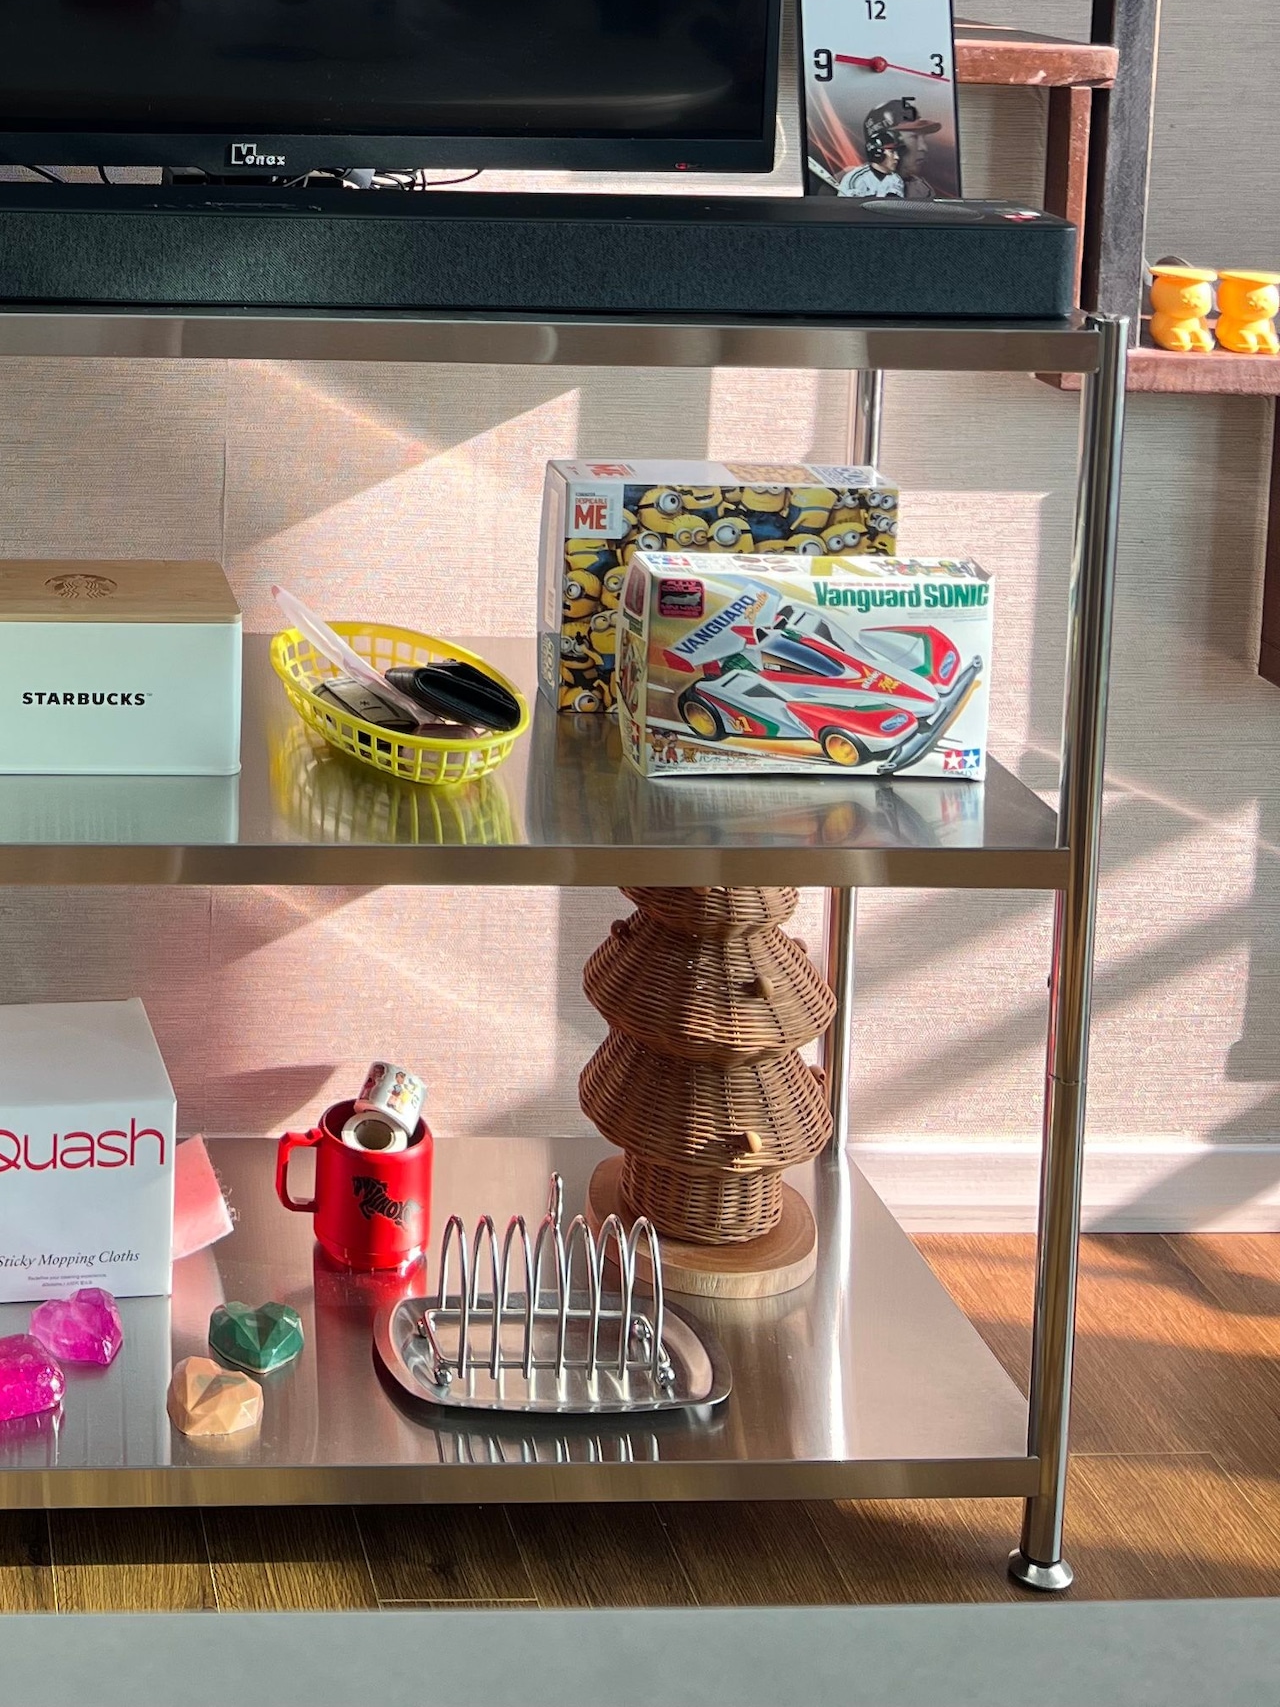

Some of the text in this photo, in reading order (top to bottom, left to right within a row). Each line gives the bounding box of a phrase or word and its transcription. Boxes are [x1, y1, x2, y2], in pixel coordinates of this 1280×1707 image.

[864, 0, 887, 20] 12
[813, 48, 833, 82] 9
[930, 53, 945, 78] 3
[901, 96, 918, 122] 5
[574, 504, 608, 530] ME
[813, 581, 990, 613] Vanguard SONIC
[674, 594, 758, 655] VANGUARD
[21, 692, 147, 707] STARBUCKS
[38, 1251, 96, 1268] Mopping
[98, 1249, 140, 1263] Cloths
